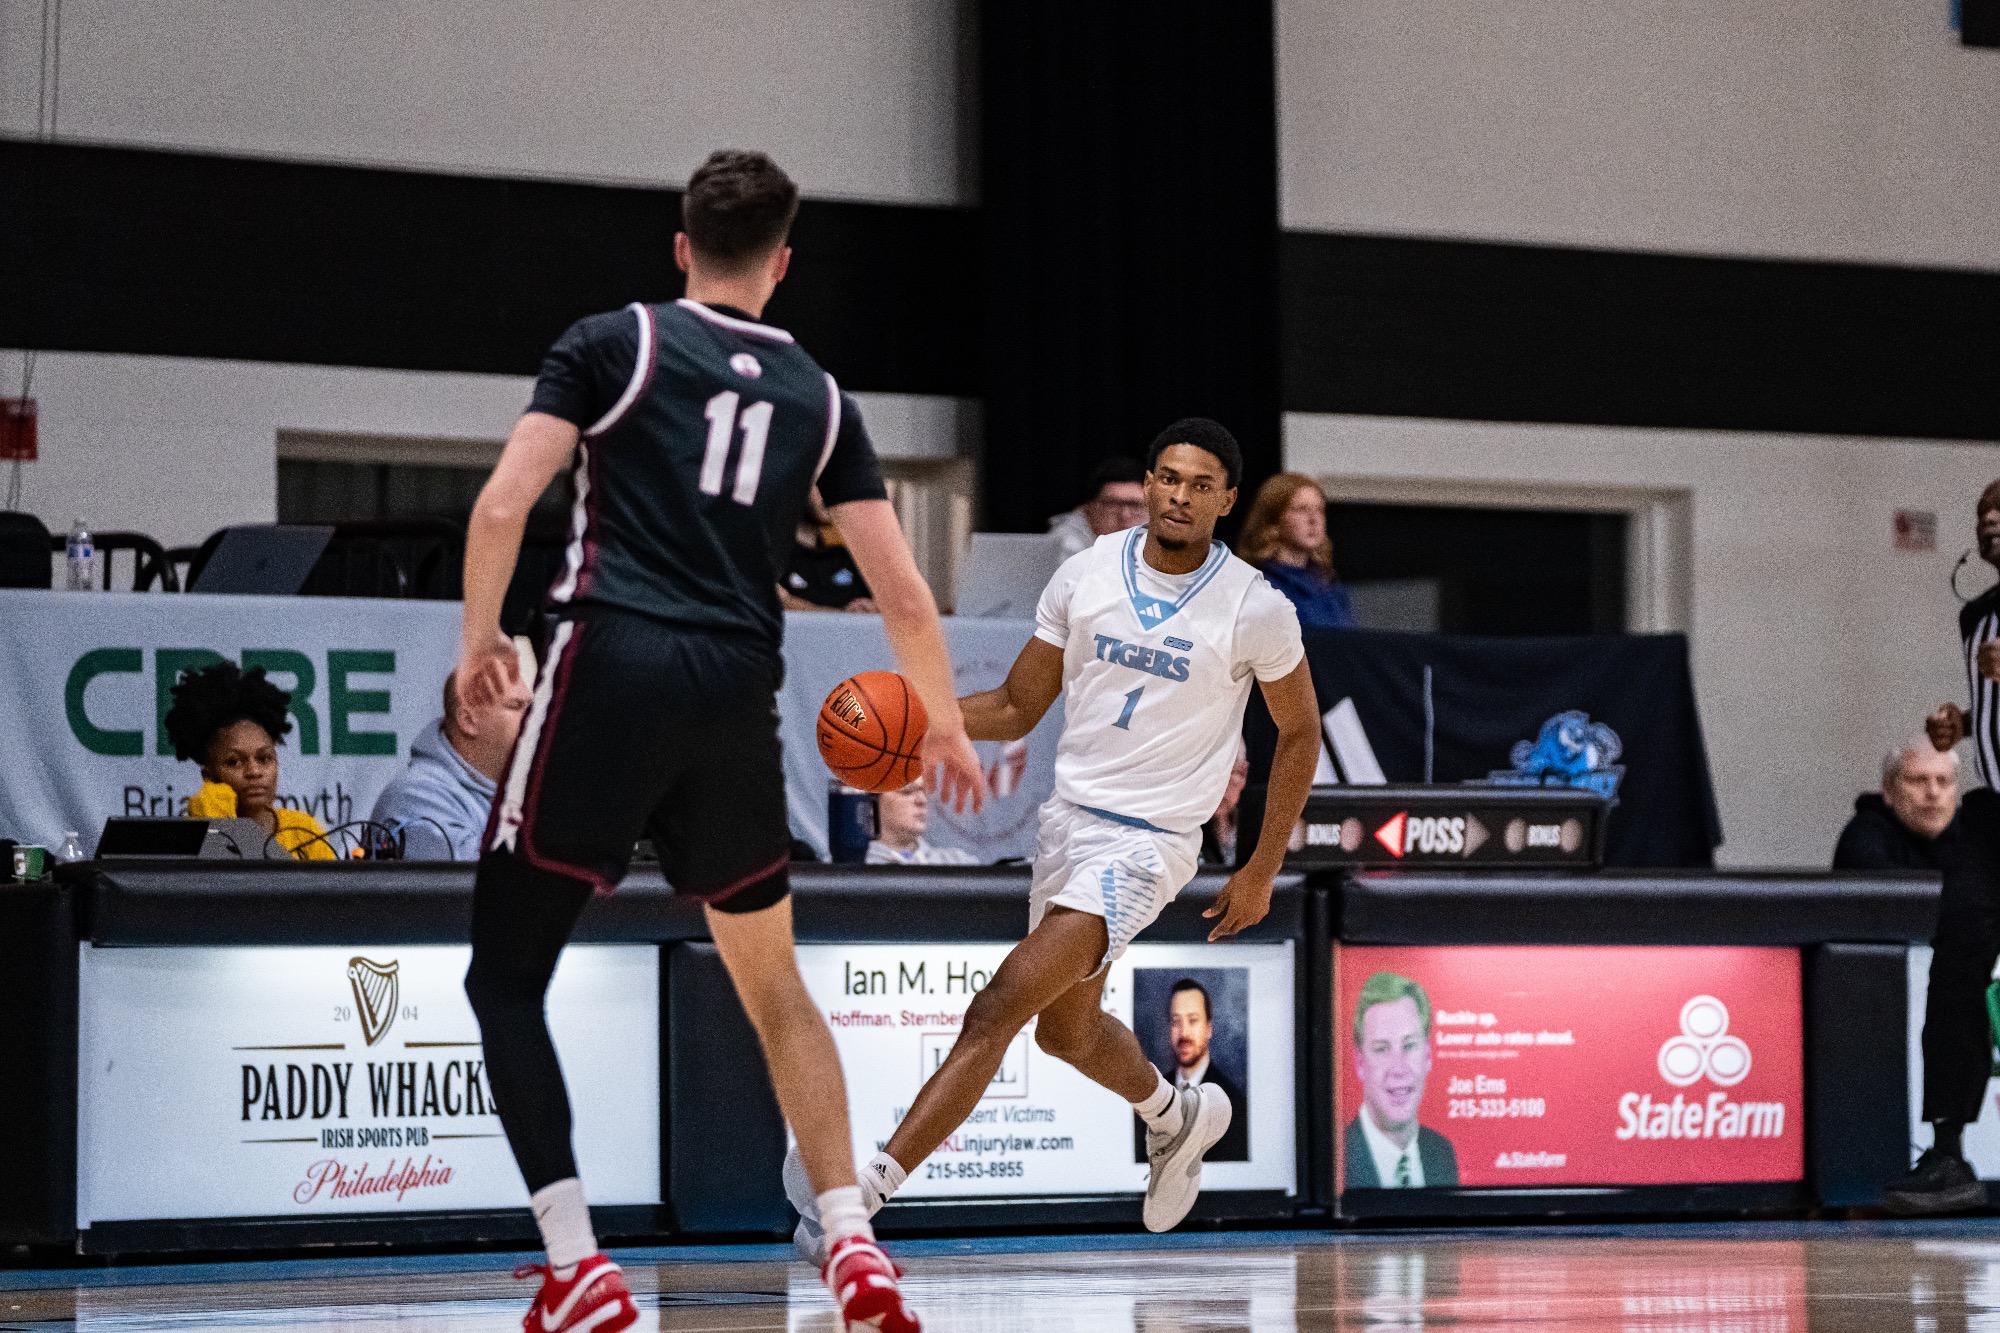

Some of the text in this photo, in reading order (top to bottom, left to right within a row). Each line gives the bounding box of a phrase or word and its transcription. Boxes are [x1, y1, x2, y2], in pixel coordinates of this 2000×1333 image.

[700, 390, 774, 507] 11
[1094, 633, 1190, 682] TIGERS
[1111, 685, 1145, 730] 1
[1306, 823, 1341, 846] BONUS
[1405, 817, 1466, 853] POSS
[1527, 824, 1561, 847] BONUS
[845, 961, 886, 995] Ian
[899, 961, 934, 995] M.
[333, 1006, 418, 1021] 20 04
[830, 1010, 966, 1028] Hoffman, Sternber
[241, 1060, 500, 1120] PADDY WHACK
[1003, 1105, 1056, 1123] Victims
[322, 1127, 429, 1148] IRISH SPORTS PUB
[293, 1155, 453, 1204] Philadelphia
[926, 1162, 1025, 1178] 215-953-8955
